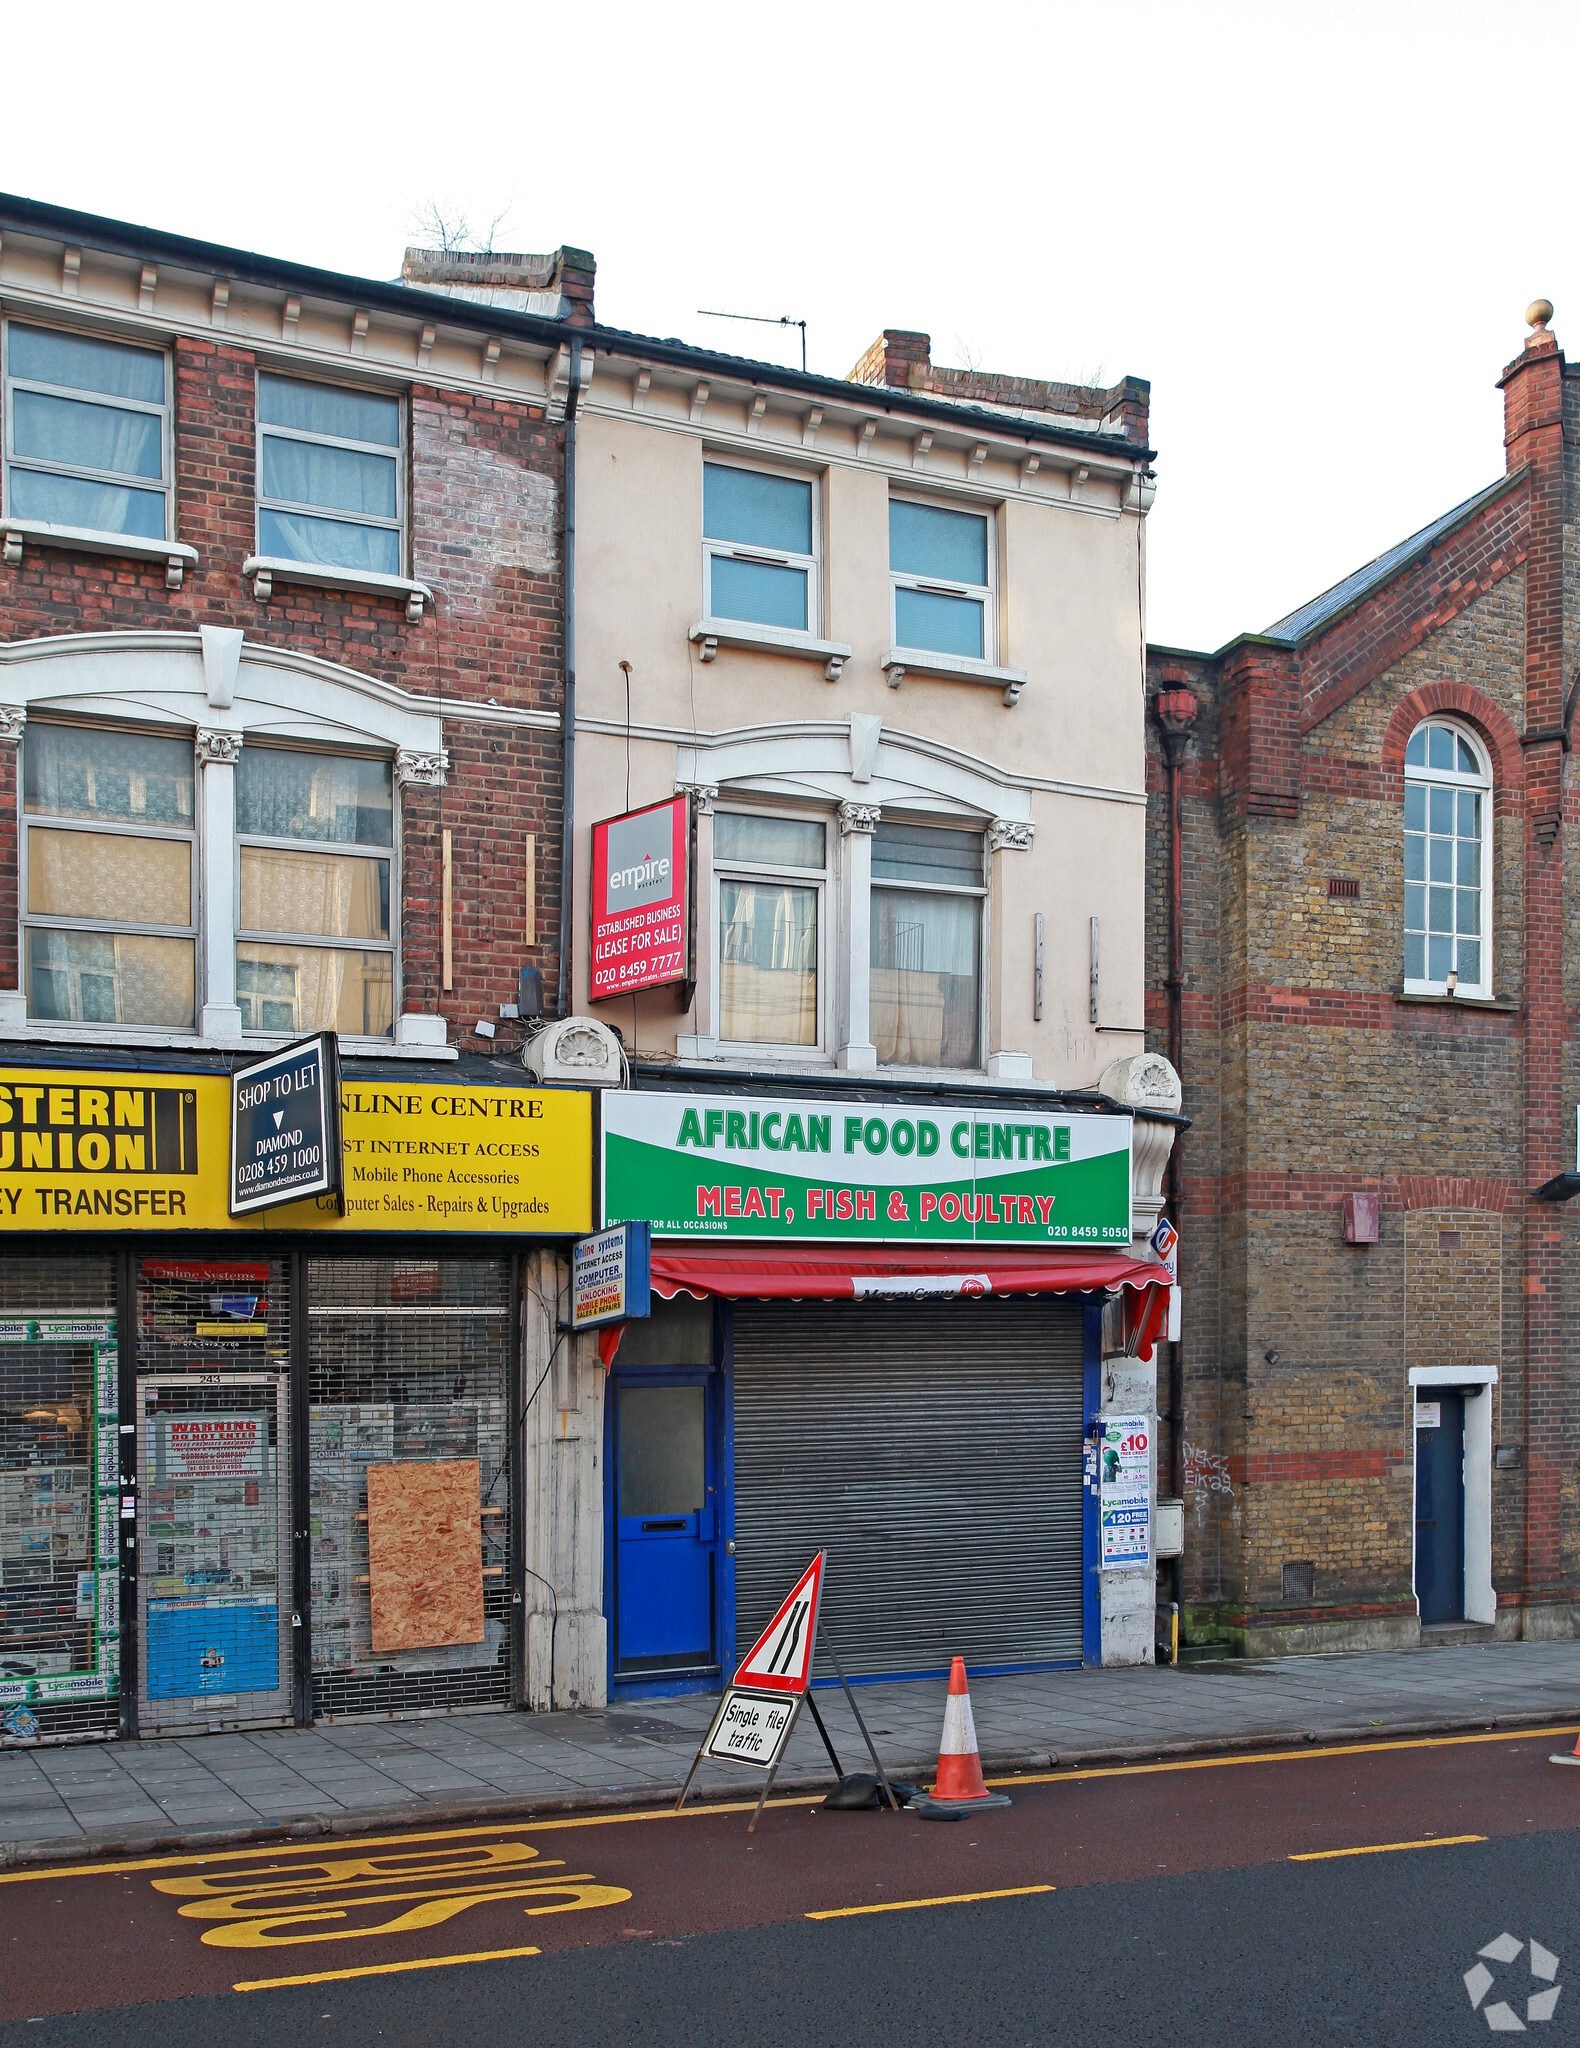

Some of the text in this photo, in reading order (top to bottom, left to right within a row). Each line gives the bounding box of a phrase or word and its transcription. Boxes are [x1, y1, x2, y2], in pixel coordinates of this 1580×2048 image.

[610, 857, 670, 890] empire
[638, 877, 664, 889] estates
[597, 904, 680, 938] ESTABLISHED BUSINESS
[595, 924, 682, 964] (LEASE FOR SALE)
[595, 951, 682, 985] 020 8459 7777
[606, 970, 671, 990] www.empire-estates.com
[238, 1063, 317, 1111] SHOP TO LET
[431, 1096, 544, 1119] CENTRE
[256, 1129, 303, 1157] DIAMOND
[675, 1107, 1071, 1162] AFRICAN FOOD CENTRE
[370, 1140, 470, 1156] INTERNET
[474, 1143, 540, 1157] ACCESS
[238, 1145, 320, 1184] 0208 459 1000
[352, 1166, 520, 1184] Mobile Phone Accessories
[238, 1167, 320, 1196] www.diamondestates.co.uk
[35, 1188, 186, 1216] TRANSFER
[383, 1194, 415, 1212] Sales
[427, 1196, 474, 1217] Repairs
[477, 1196, 488, 1213] &
[492, 1197, 550, 1220] Upgrades
[696, 1185, 1056, 1225] MEAT, FISH & POULTRY
[666, 1220, 681, 1229] ALL
[683, 1220, 728, 1230] OCCASIONS
[1047, 1225, 1129, 1238] 020 8459 5050
[574, 1234, 624, 1260] Online systems
[575, 1250, 623, 1272] INTERNET ACCESS
[153, 1266, 256, 1285] Online Systems
[578, 1264, 619, 1285] COMPUTER
[577, 1293, 621, 1313] MOBILE PHONE
[580, 1284, 618, 1301] UNLOCKING
[576, 1309, 593, 1319] SALES
[599, 1301, 621, 1314] REPAIRS
[48, 1324, 104, 1333] Lycamobile
[107, 1359, 115, 1409] Lycamobile
[200, 1374, 220, 1383] 243
[171, 1421, 257, 1432] WARNING
[1105, 1420, 1145, 1428] Lycamobile
[1120, 1433, 1148, 1452] £10
[1102, 1497, 1149, 1508] Lycamobile
[1110, 1512, 1131, 1524] 120
[48, 1679, 104, 1690] Lycamobile
[726, 1704, 784, 1730] Single file
[728, 1729, 763, 1752] traffic
[150, 1841, 633, 1948] BUS
